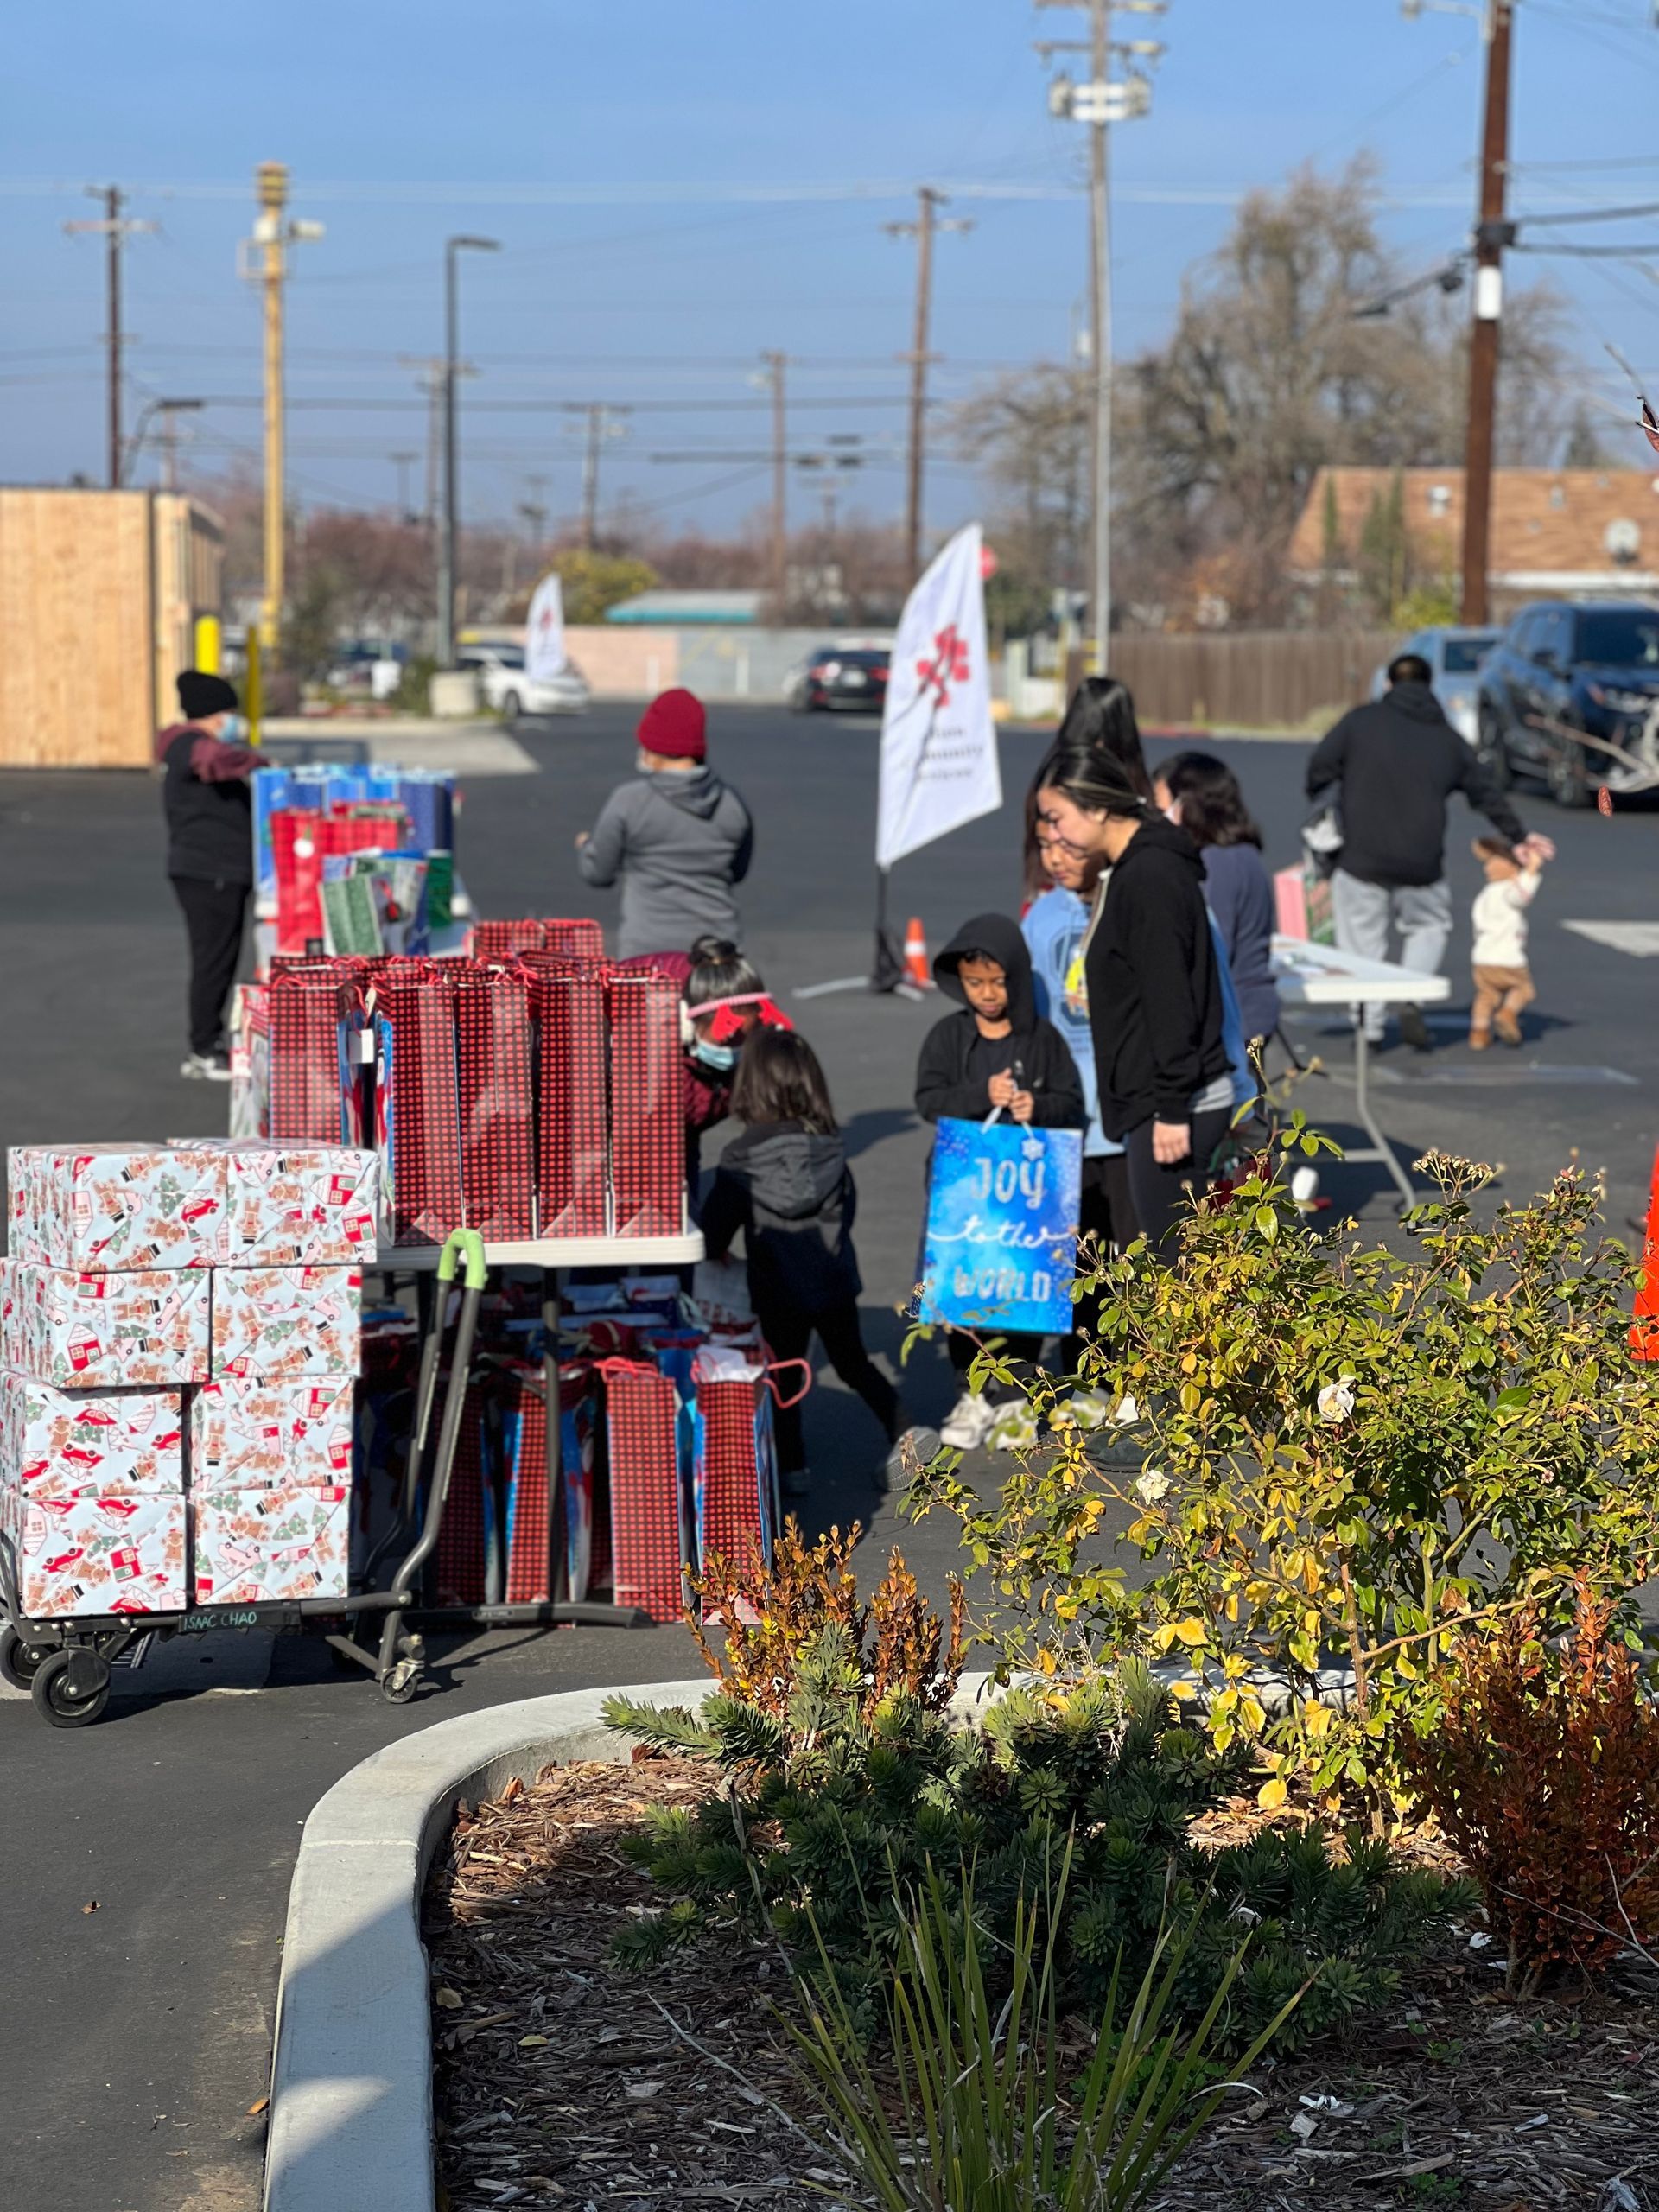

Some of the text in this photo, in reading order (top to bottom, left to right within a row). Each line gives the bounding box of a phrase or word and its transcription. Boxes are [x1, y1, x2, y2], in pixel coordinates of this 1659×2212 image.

[954, 1265, 1052, 1302] WORLD
[183, 1611, 257, 1630] ISAAC CHAO
